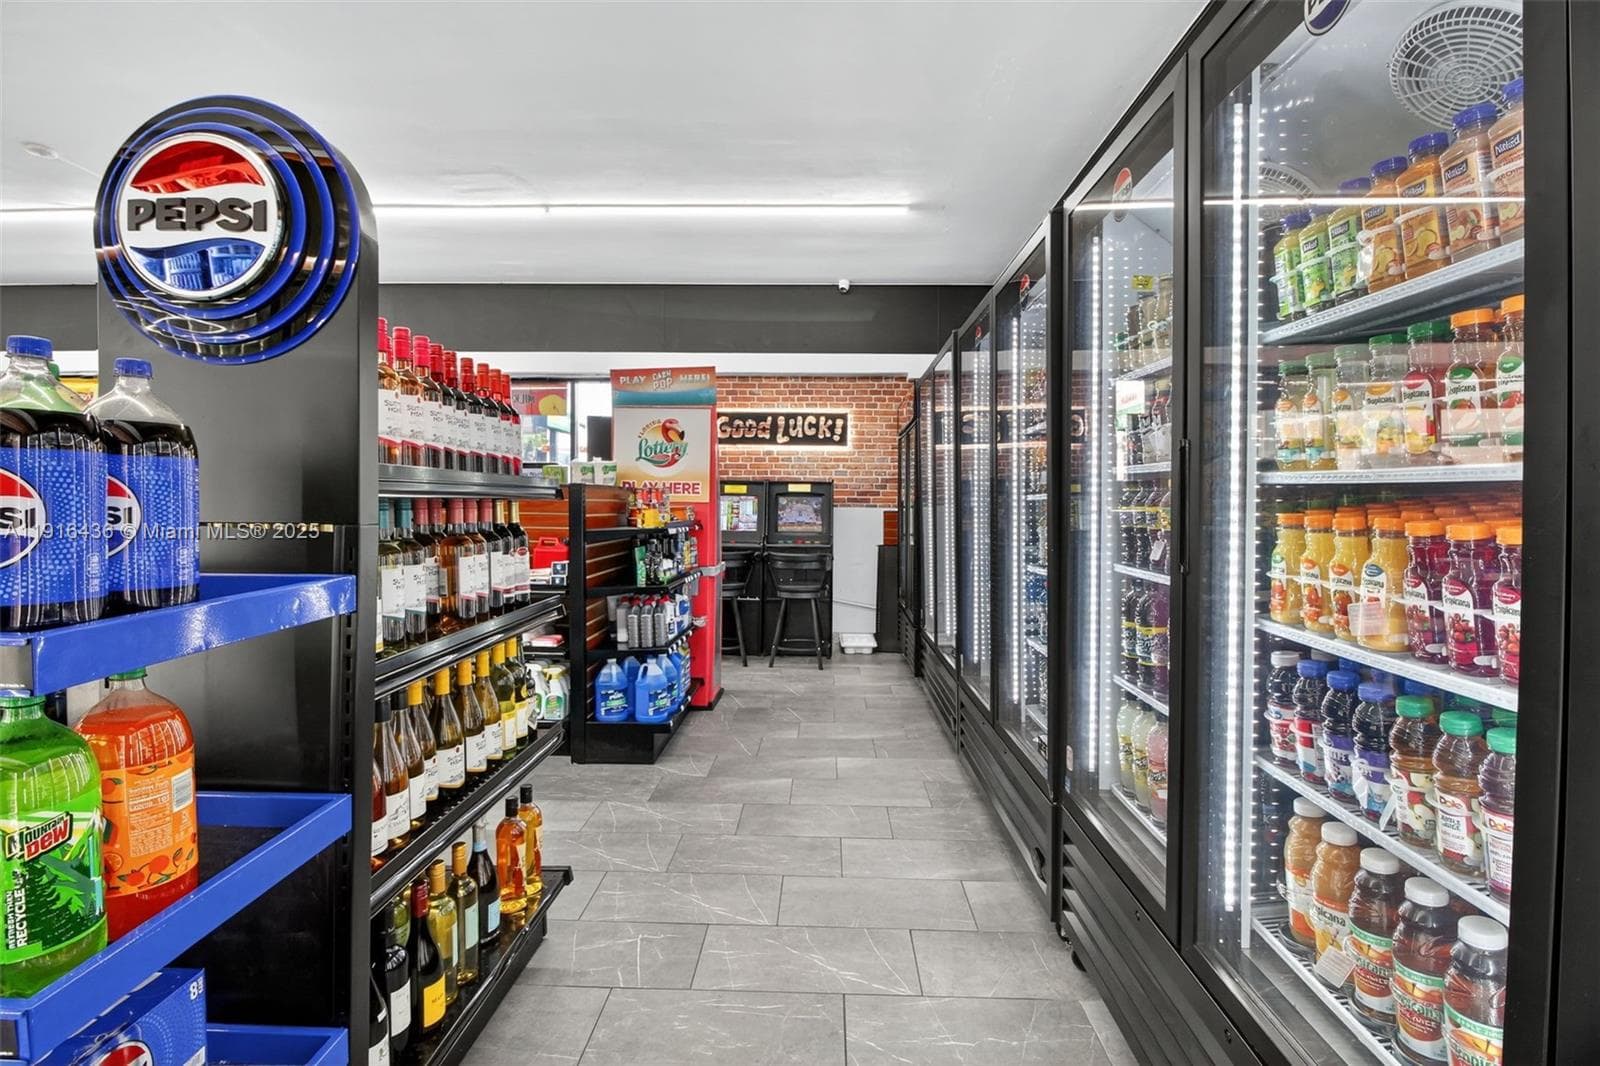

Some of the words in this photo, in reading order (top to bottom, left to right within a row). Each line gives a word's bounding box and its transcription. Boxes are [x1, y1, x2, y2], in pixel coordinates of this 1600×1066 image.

[127, 197, 268, 233] PEPSI
[620, 376, 646, 384] PLAY
[653, 378, 672, 389] POP
[635, 438, 688, 462] Lottery
[14, 887, 28, 948] RECYCLE
[190, 981, 198, 1000] 8
